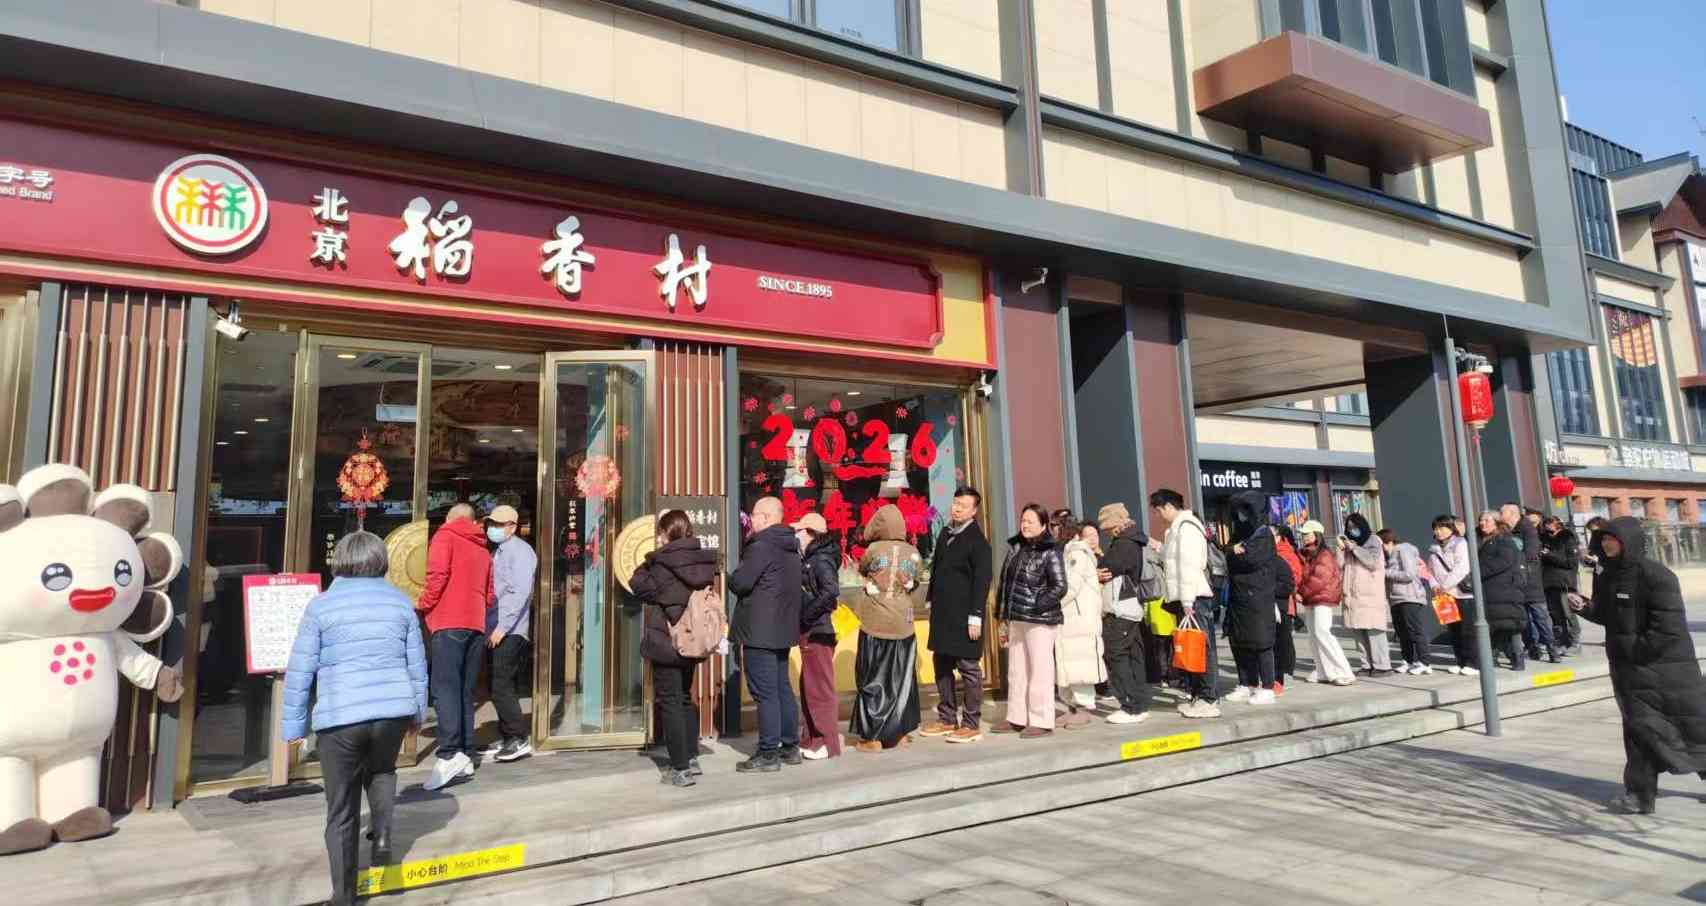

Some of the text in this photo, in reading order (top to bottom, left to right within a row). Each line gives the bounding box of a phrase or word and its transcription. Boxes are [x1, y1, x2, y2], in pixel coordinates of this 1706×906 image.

[20, 187, 53, 200] Brand
[310, 187, 348, 262] 北京
[389, 197, 712, 307] 稻香村
[759, 276, 833, 297] SINCE 1895
[761, 413, 937, 468] 2026
[1213, 469, 1248, 488] coffee
